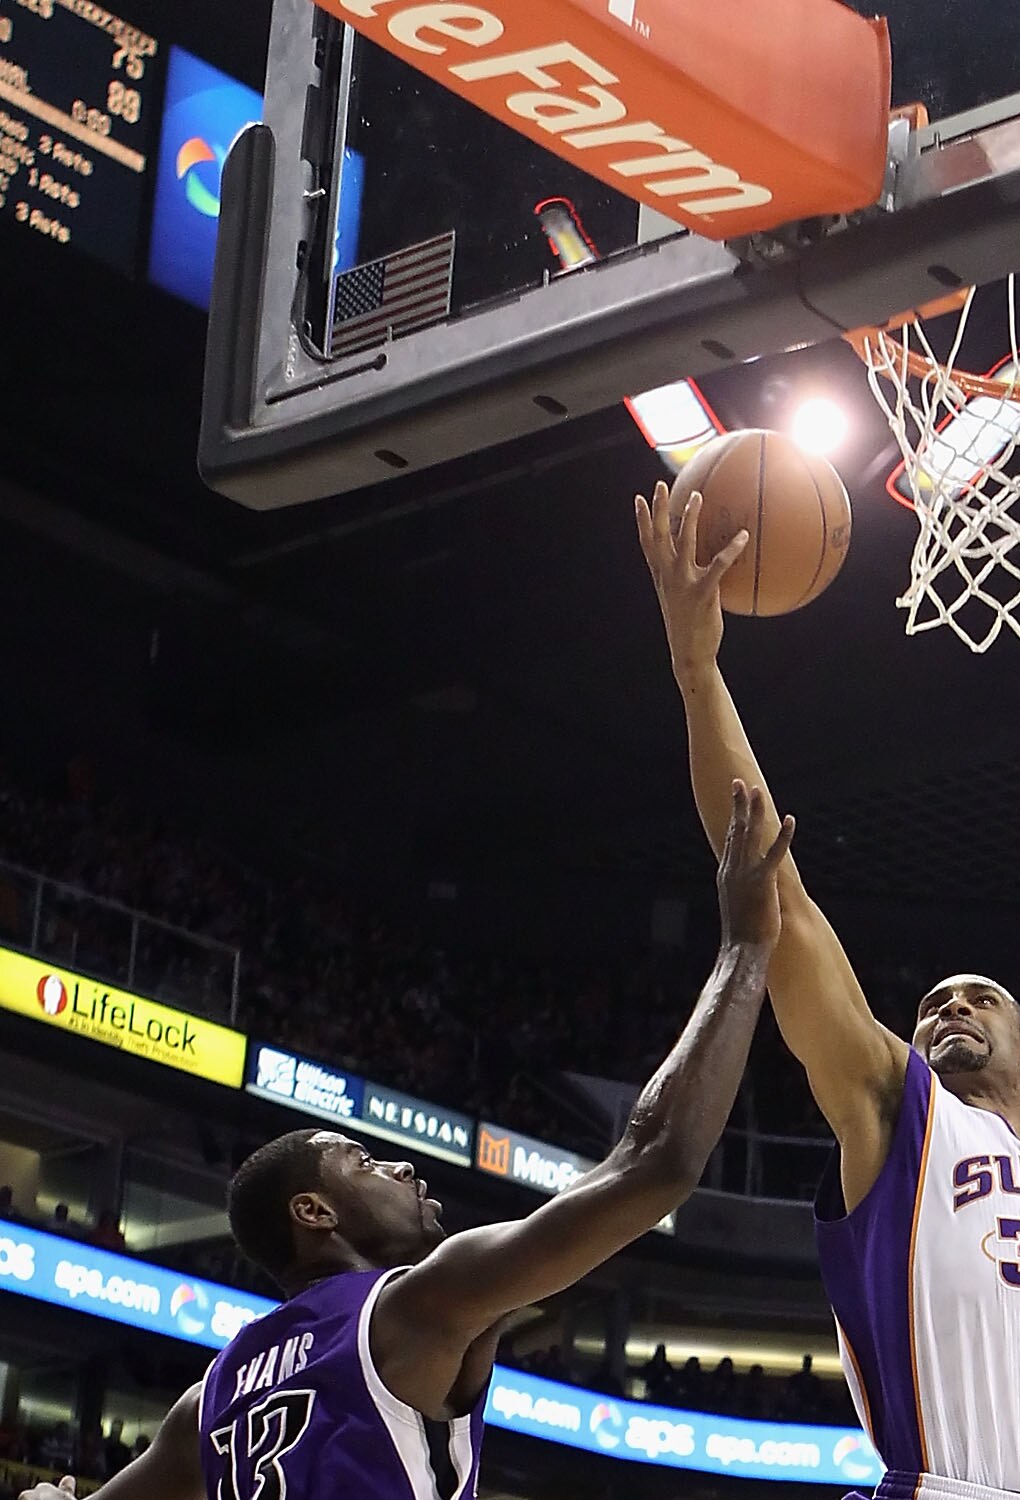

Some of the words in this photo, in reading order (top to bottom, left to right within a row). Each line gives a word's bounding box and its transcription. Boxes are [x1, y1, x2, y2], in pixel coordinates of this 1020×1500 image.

[447, 40, 773, 215] Farm
[72, 983, 196, 1055] LifeLock
[624, 1416, 695, 1459] aps
